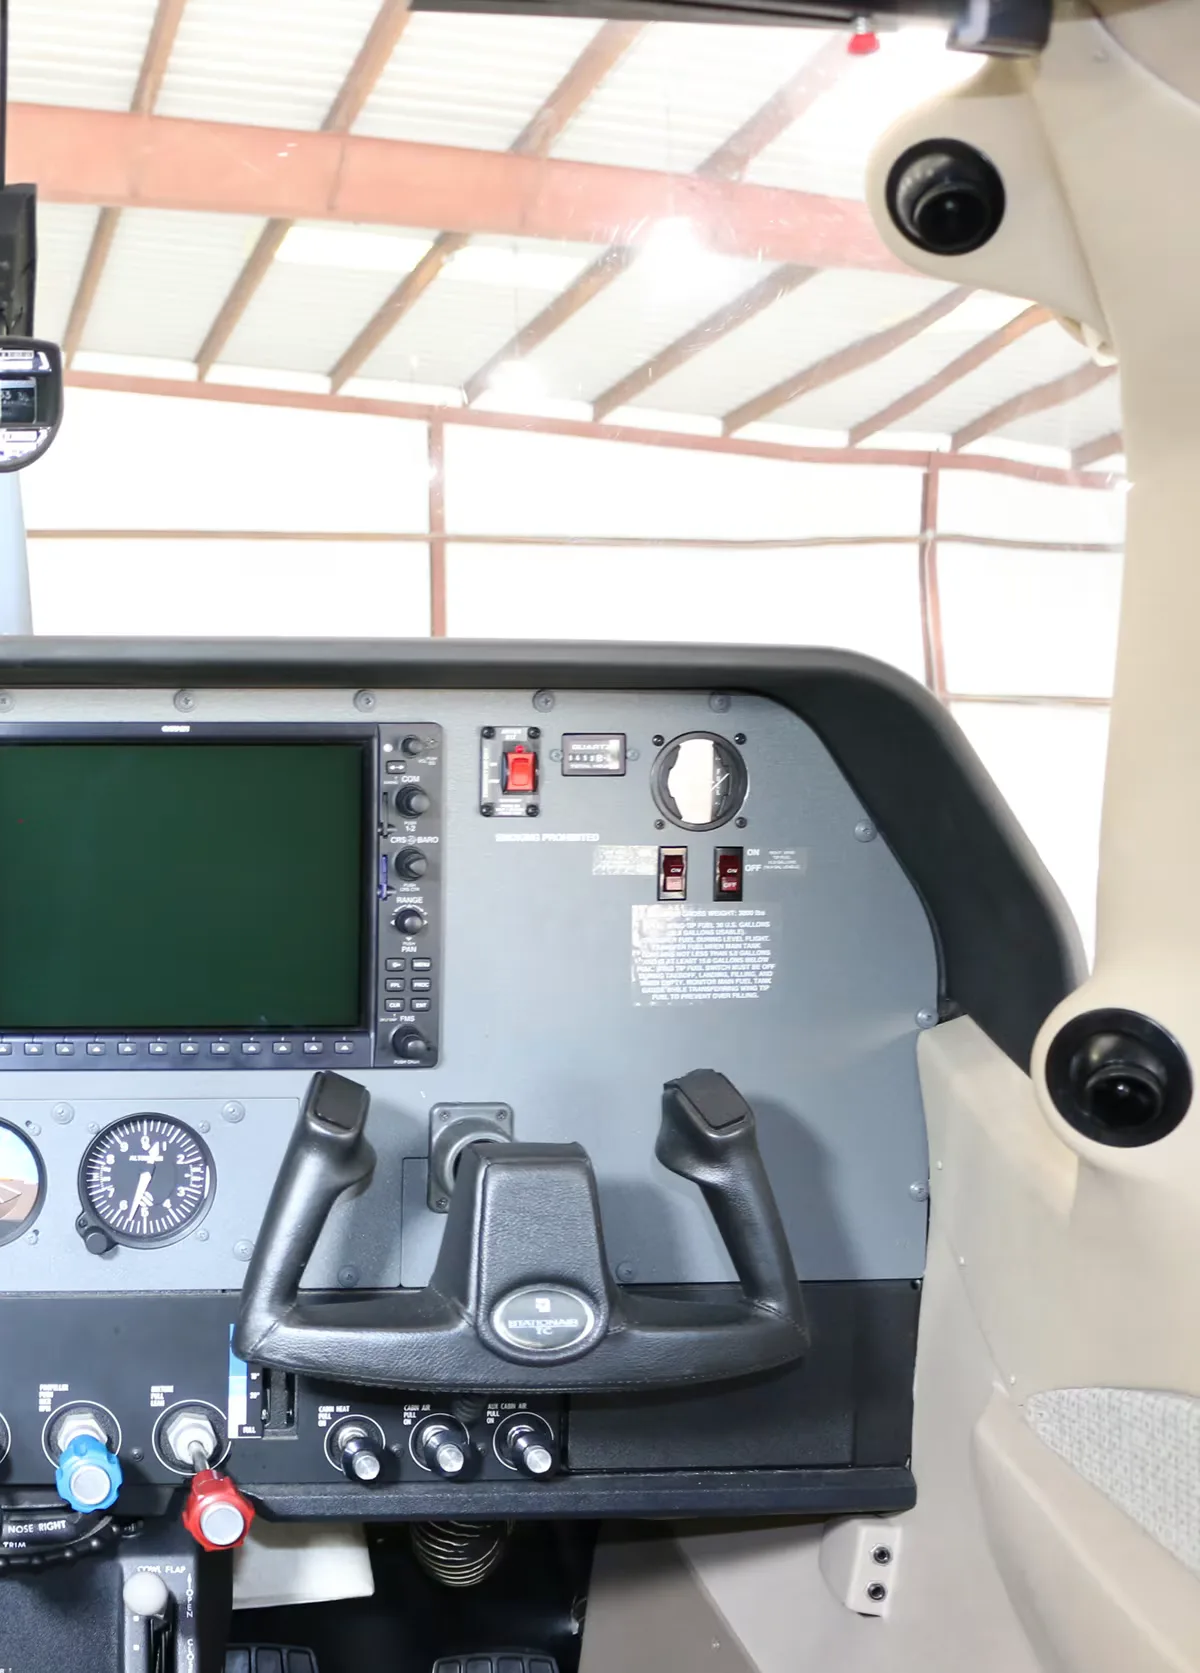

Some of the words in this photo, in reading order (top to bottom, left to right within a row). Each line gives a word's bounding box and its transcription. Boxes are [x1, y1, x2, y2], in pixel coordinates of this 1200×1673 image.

[745, 864, 762, 872] OFF
[120, 1142, 129, 1152] 9
[163, 1142, 167, 1151] 1
[106, 1154, 115, 1164] 8
[176, 1154, 185, 1164] 2
[108, 1187, 115, 1198] 7
[177, 1186, 185, 1197] 3
[119, 1200, 128, 1210] 6
[163, 1199, 172, 1208] 4
[141, 1207, 149, 1217] 5
[336, 1405, 350, 1413] HEAT
[403, 1411, 416, 1419] PULL
[8, 1524, 33, 1534] NOSE
[38, 1520, 66, 1532] RIGHT
[186, 1589, 194, 1618] OPEN
